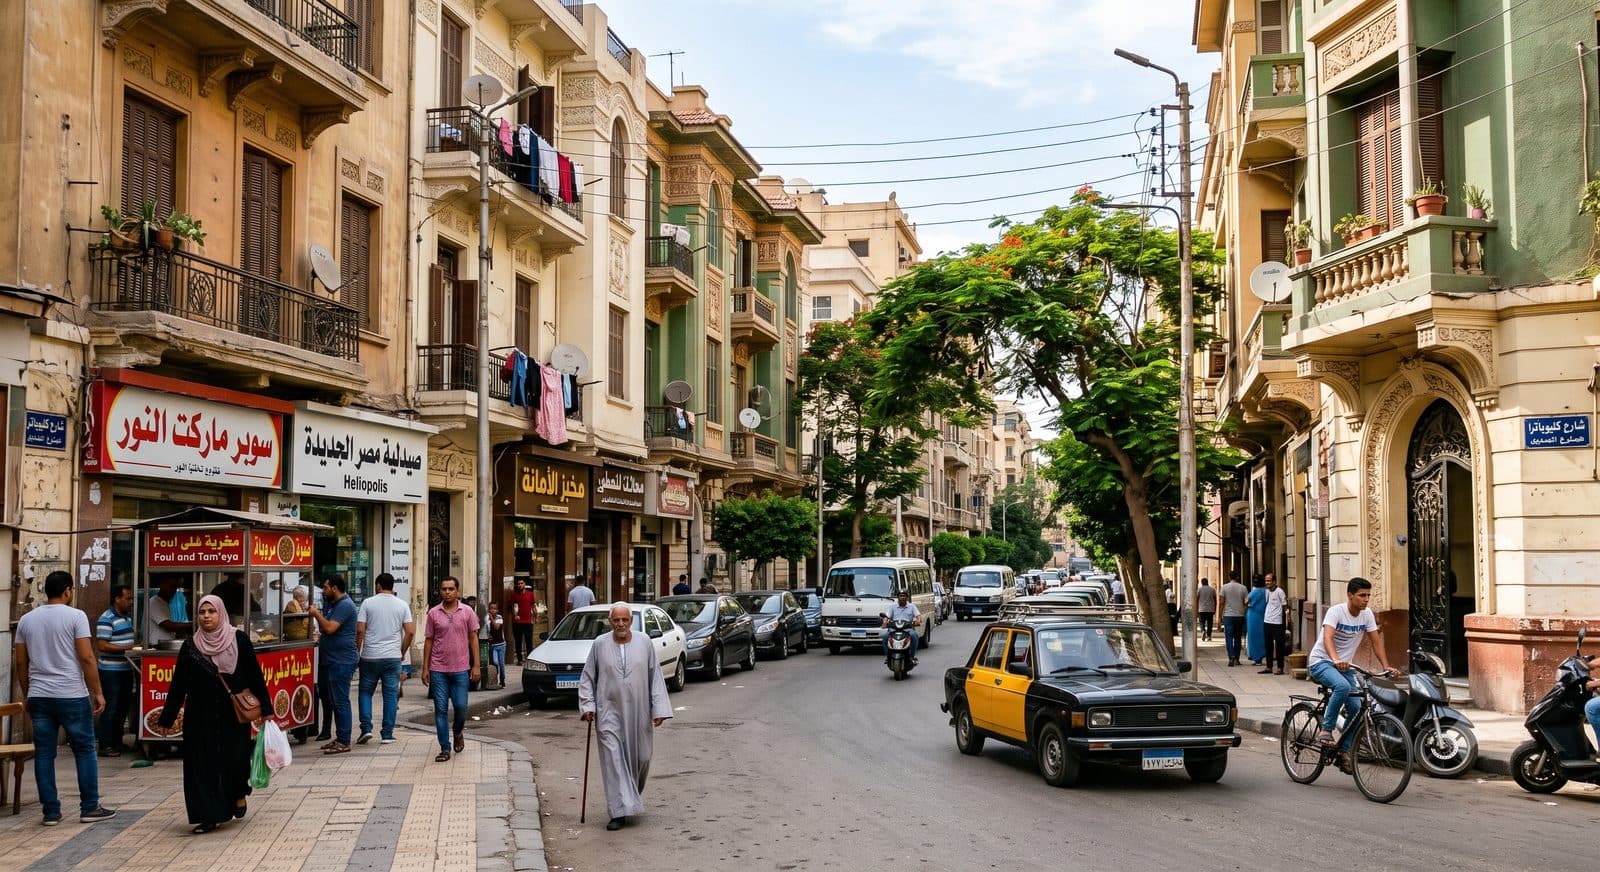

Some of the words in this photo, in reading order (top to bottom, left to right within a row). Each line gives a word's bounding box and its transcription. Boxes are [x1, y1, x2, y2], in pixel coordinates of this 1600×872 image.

[116, 404, 167, 452] النور
[171, 412, 229, 459] ماركت
[1563, 418, 1586, 434] شارع
[304, 425, 354, 467] الجديدة
[354, 446, 380, 470] مصر
[383, 438, 422, 476] صيدلية
[343, 474, 388, 494] Heliopolis
[522, 465, 558, 496] الأمانة
[560, 473, 585, 503] مخبز
[153, 536, 177, 548] Foul
[154, 552, 175, 562] Foul
[177, 552, 196, 562] and
[198, 552, 239, 563] Tam'eya
